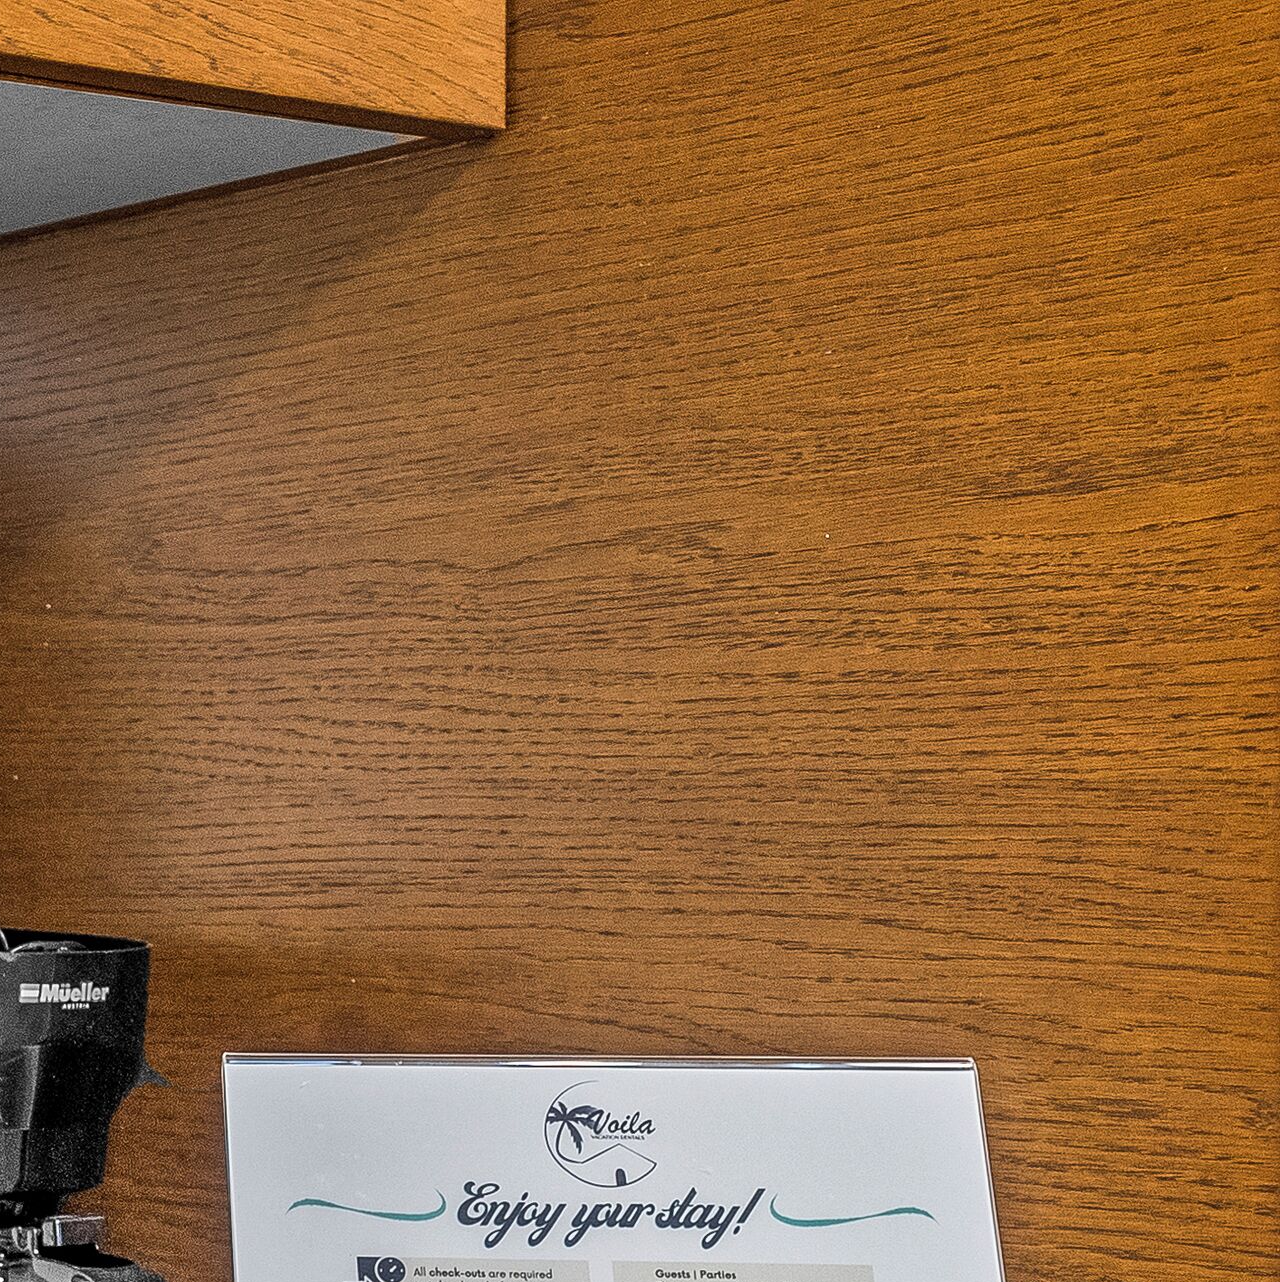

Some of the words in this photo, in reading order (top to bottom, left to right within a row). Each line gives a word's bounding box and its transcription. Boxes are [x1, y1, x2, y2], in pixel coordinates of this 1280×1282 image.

[40, 982, 109, 1003] Müeller
[588, 1109, 655, 1135] Voila
[457, 1181, 566, 1249] Enjoy
[564, 1202, 655, 1248] your
[654, 1187, 766, 1249] stay!
[413, 1266, 427, 1277] All
[428, 1266, 486, 1278] check-outs
[488, 1271, 507, 1279] are
[509, 1268, 553, 1282] required
[655, 1268, 691, 1279] Guests
[699, 1269, 737, 1280] Parties
